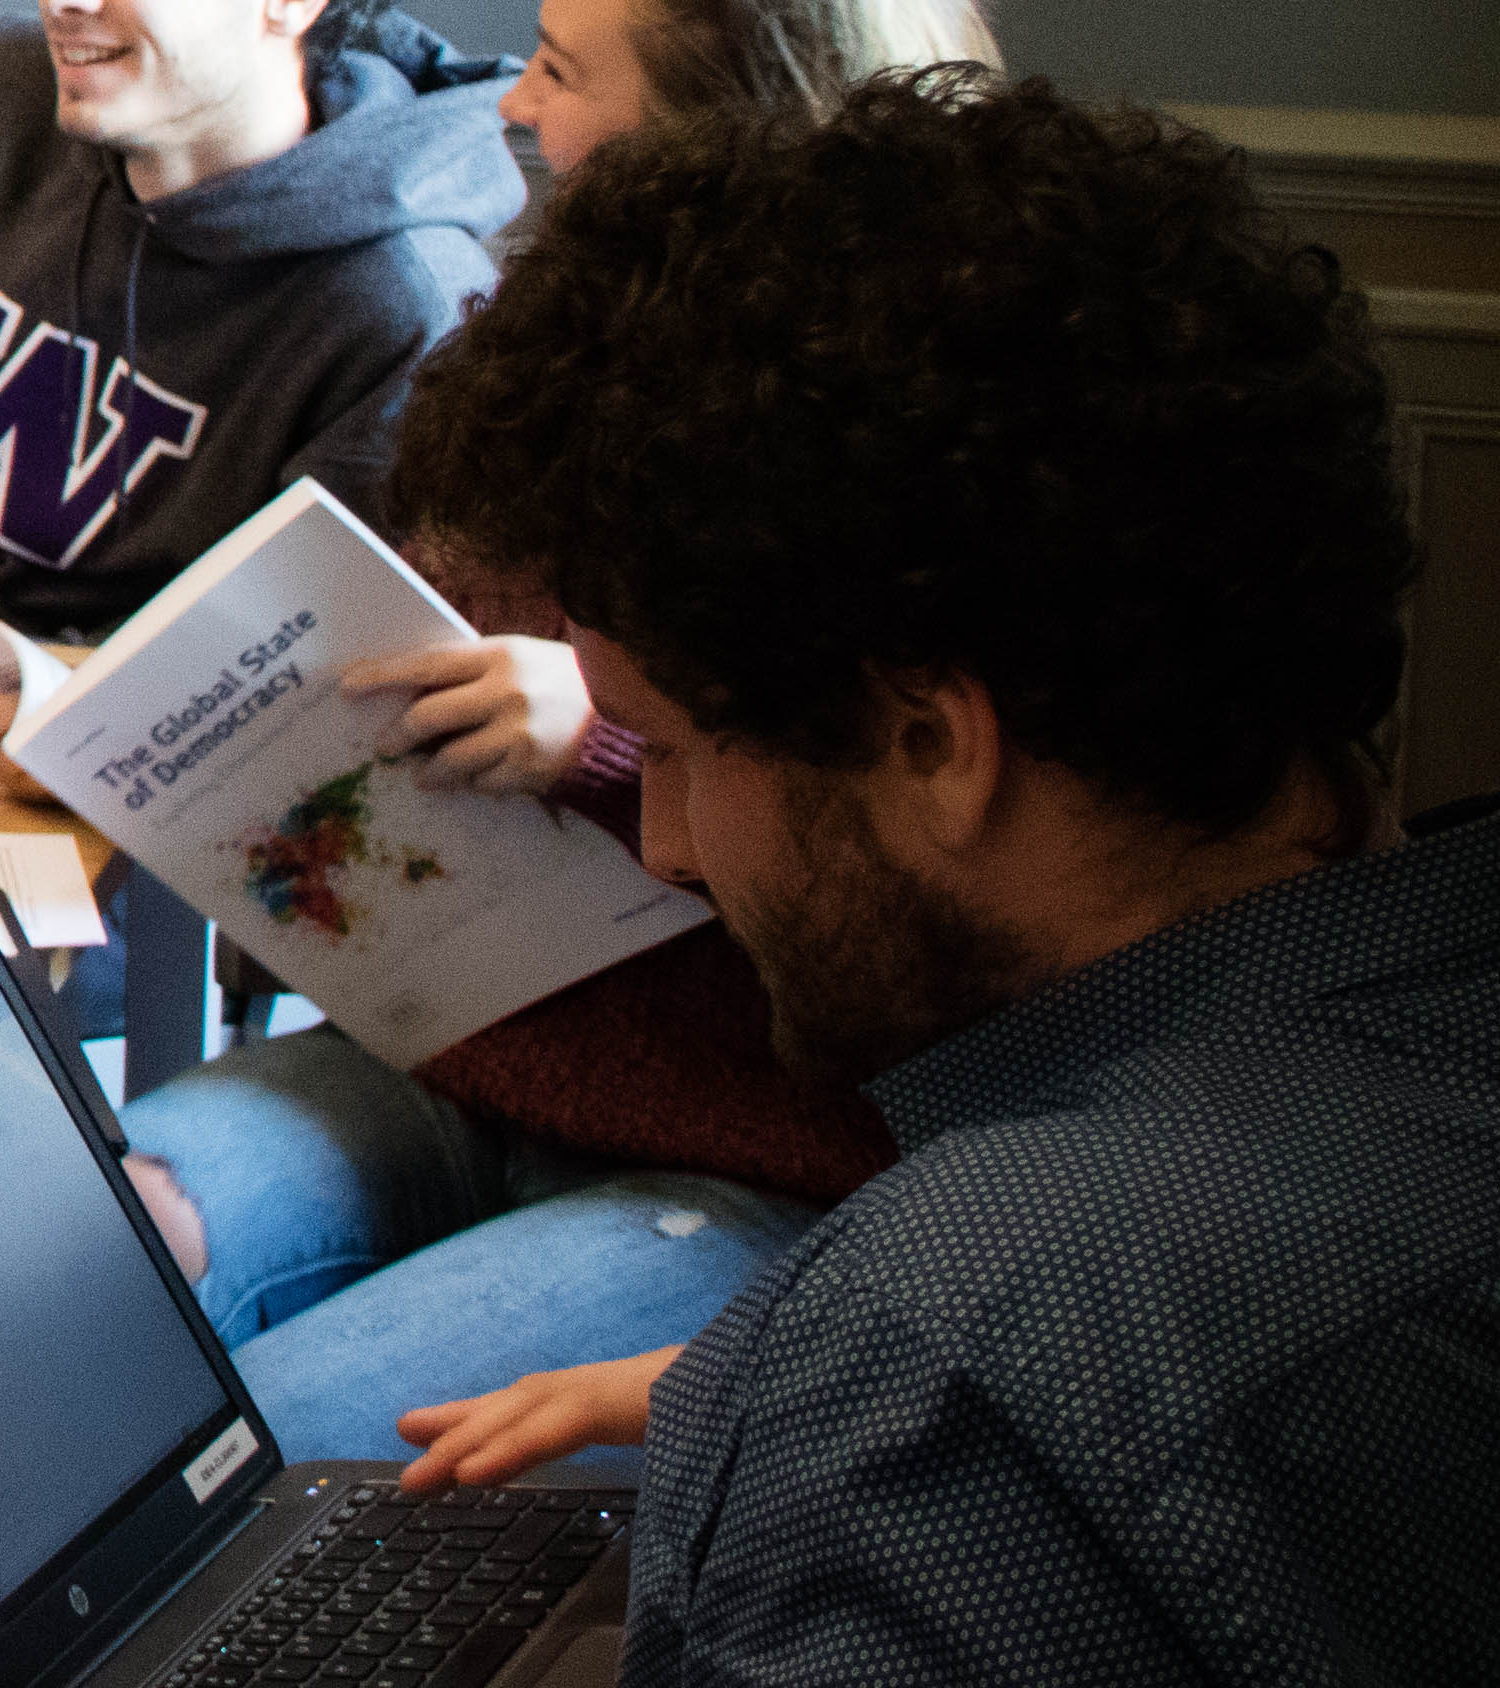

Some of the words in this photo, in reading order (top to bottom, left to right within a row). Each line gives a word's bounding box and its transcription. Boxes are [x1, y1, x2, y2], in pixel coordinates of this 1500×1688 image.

[92, 744, 153, 788] The
[150, 668, 244, 747] Global
[237, 611, 318, 677] State
[124, 775, 156, 810] of
[150, 661, 303, 786] Democracy
